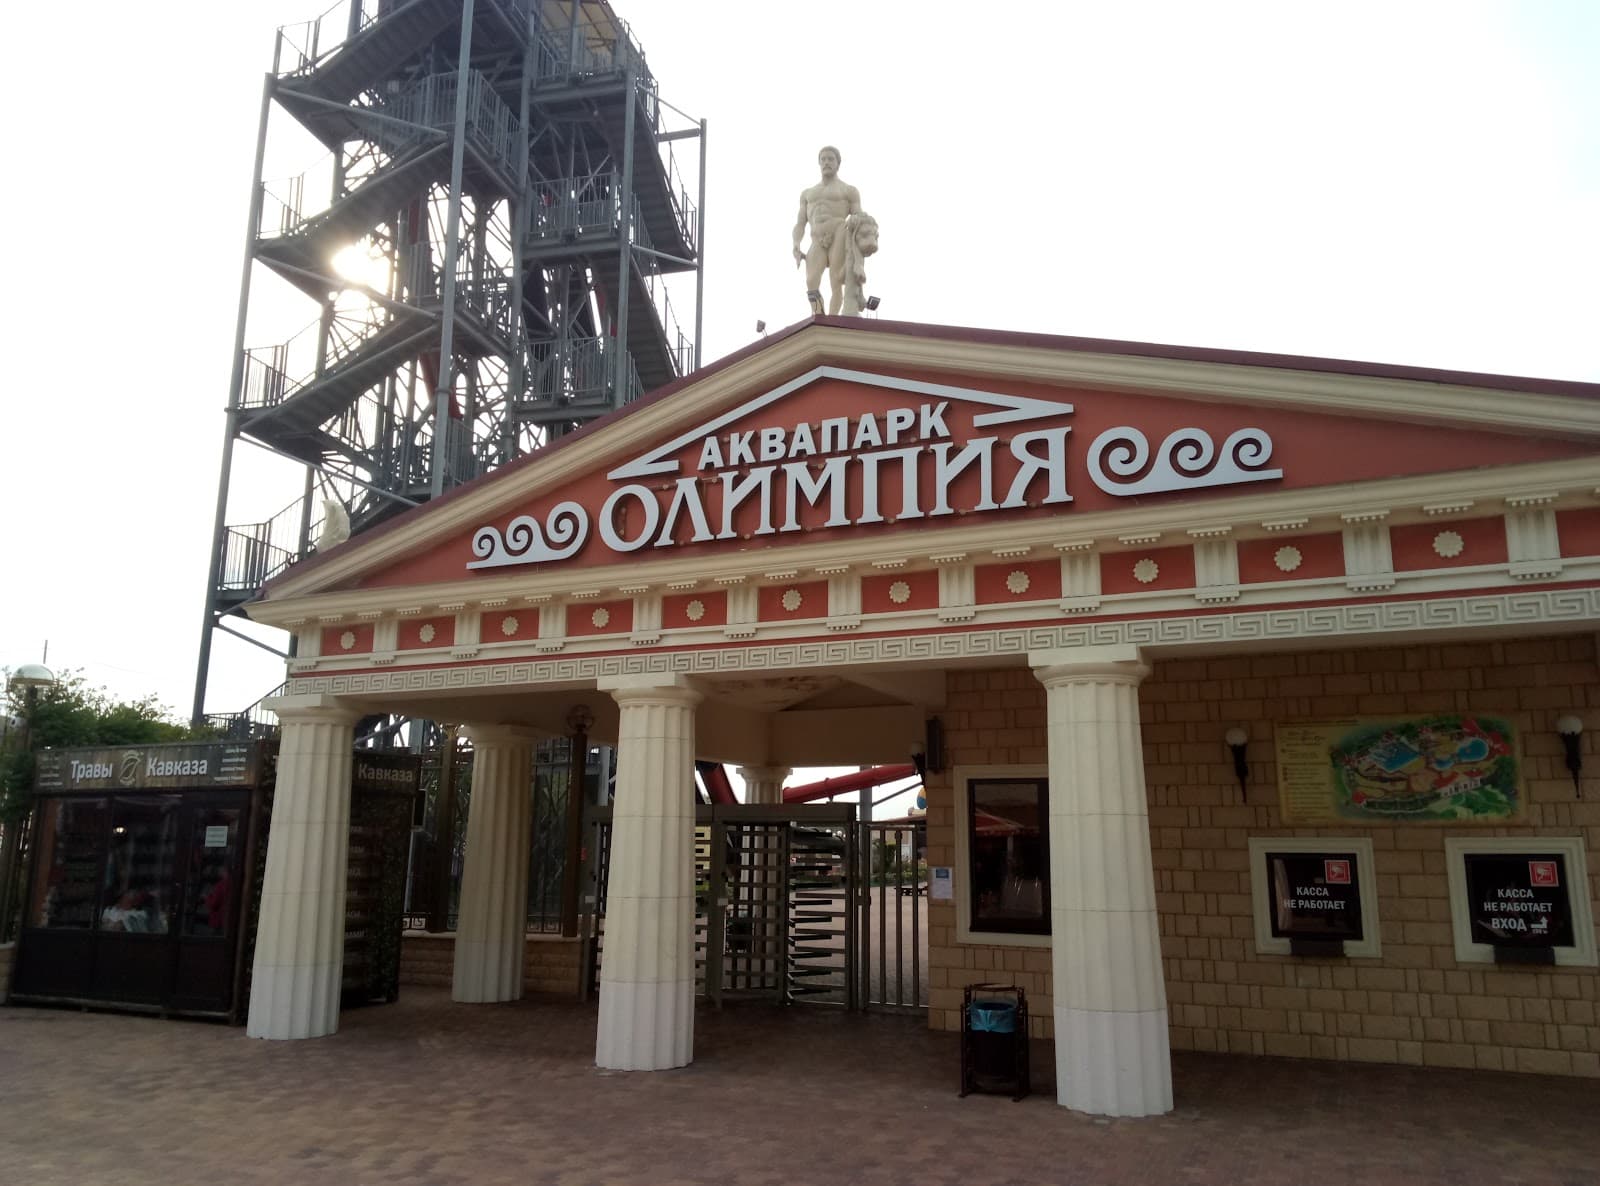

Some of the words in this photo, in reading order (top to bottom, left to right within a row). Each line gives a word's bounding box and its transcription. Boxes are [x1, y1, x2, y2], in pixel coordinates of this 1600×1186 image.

[697, 401, 953, 470] АКВАПАРК
[598, 426, 1074, 553] ОЛИМПИЯ
[70, 760, 113, 783] Травы
[146, 758, 209, 777] Кавказа
[358, 763, 414, 783] Кавказа
[1296, 887, 1329, 896] КАССА
[1497, 889, 1534, 898] КАССА
[1284, 900, 1297, 909] НЕ
[1298, 900, 1346, 910] РАБОТАЕТ
[1483, 902, 1499, 912] НЕ
[1500, 902, 1552, 912] РАБОТАЕТ
[1492, 918, 1527, 931] ВХОД
